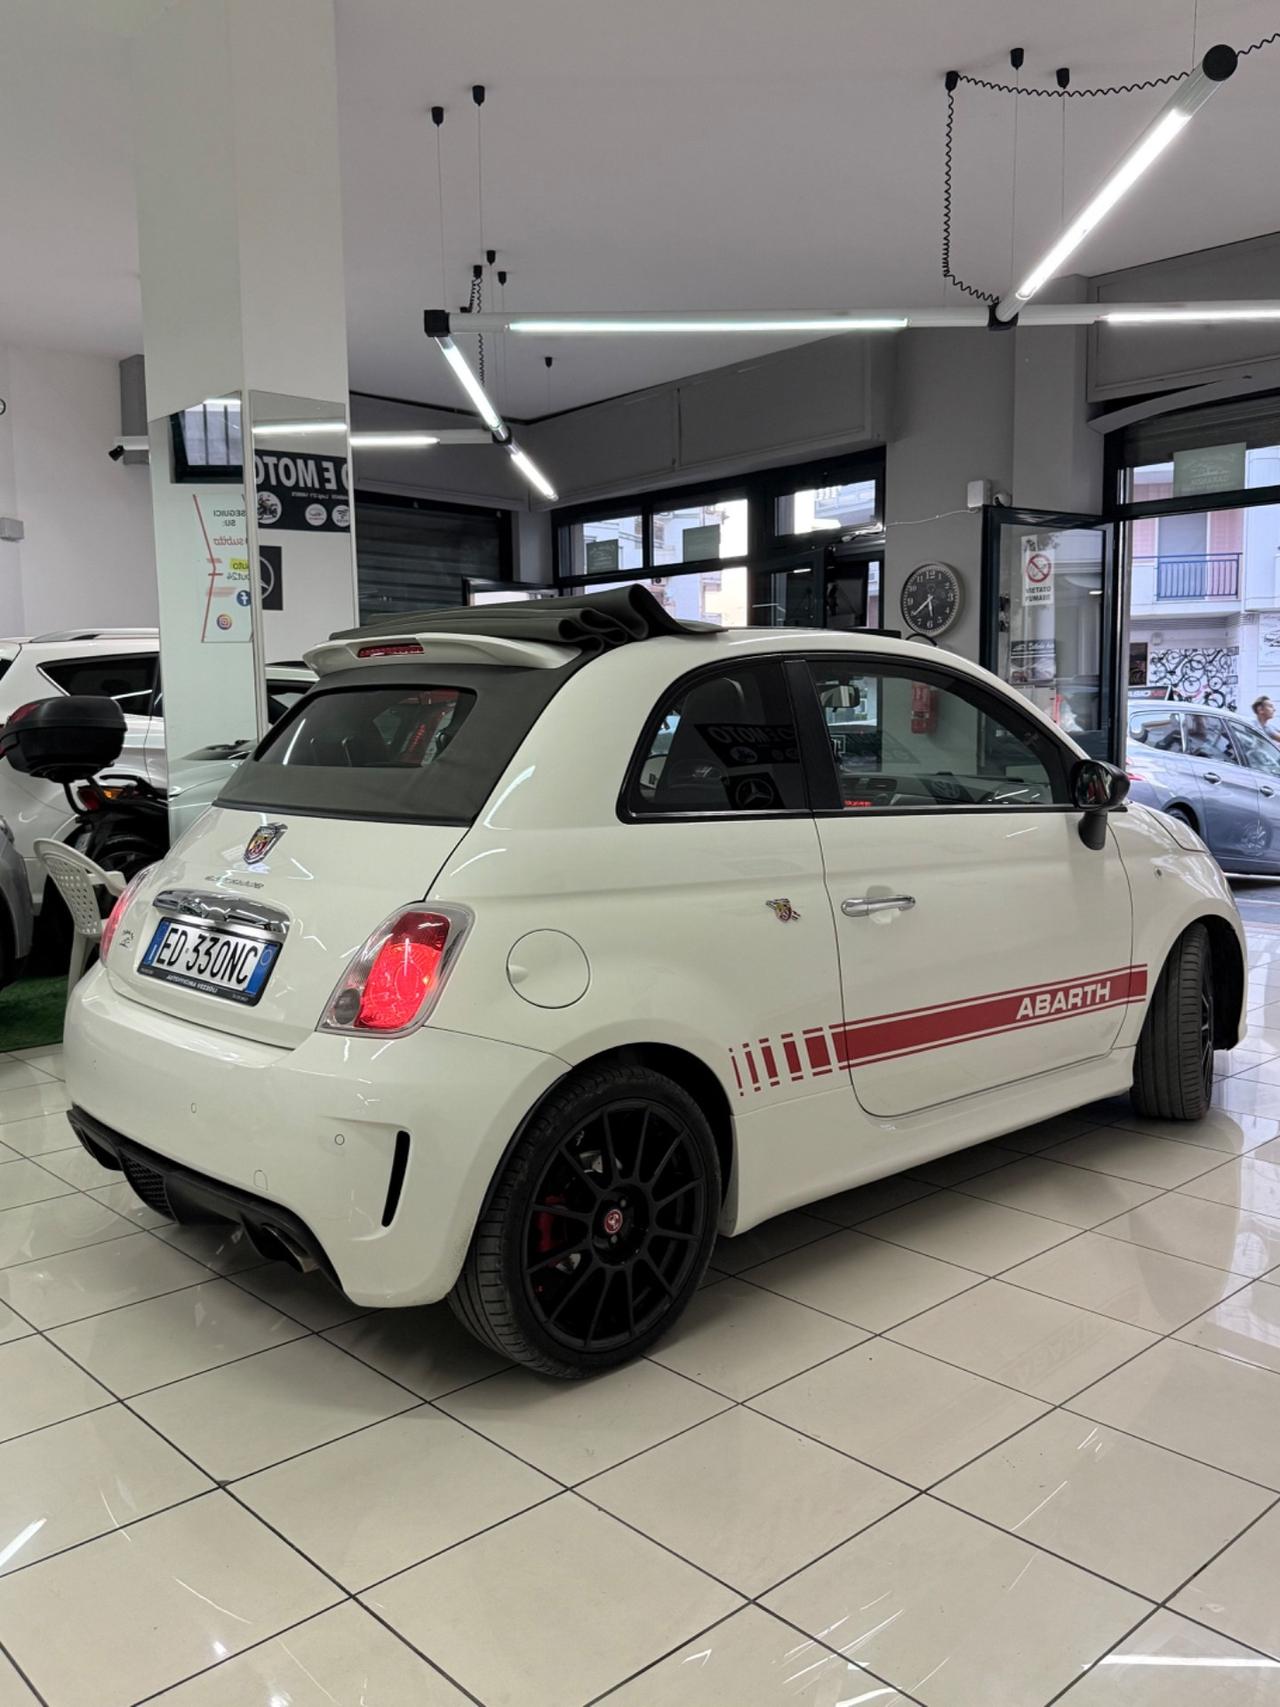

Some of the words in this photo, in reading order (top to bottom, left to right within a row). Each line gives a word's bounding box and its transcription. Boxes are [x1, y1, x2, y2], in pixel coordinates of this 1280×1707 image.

[156, 927, 189, 967] ED
[186, 933, 258, 985] 330NC
[1016, 981, 1110, 1020] ABARTH
